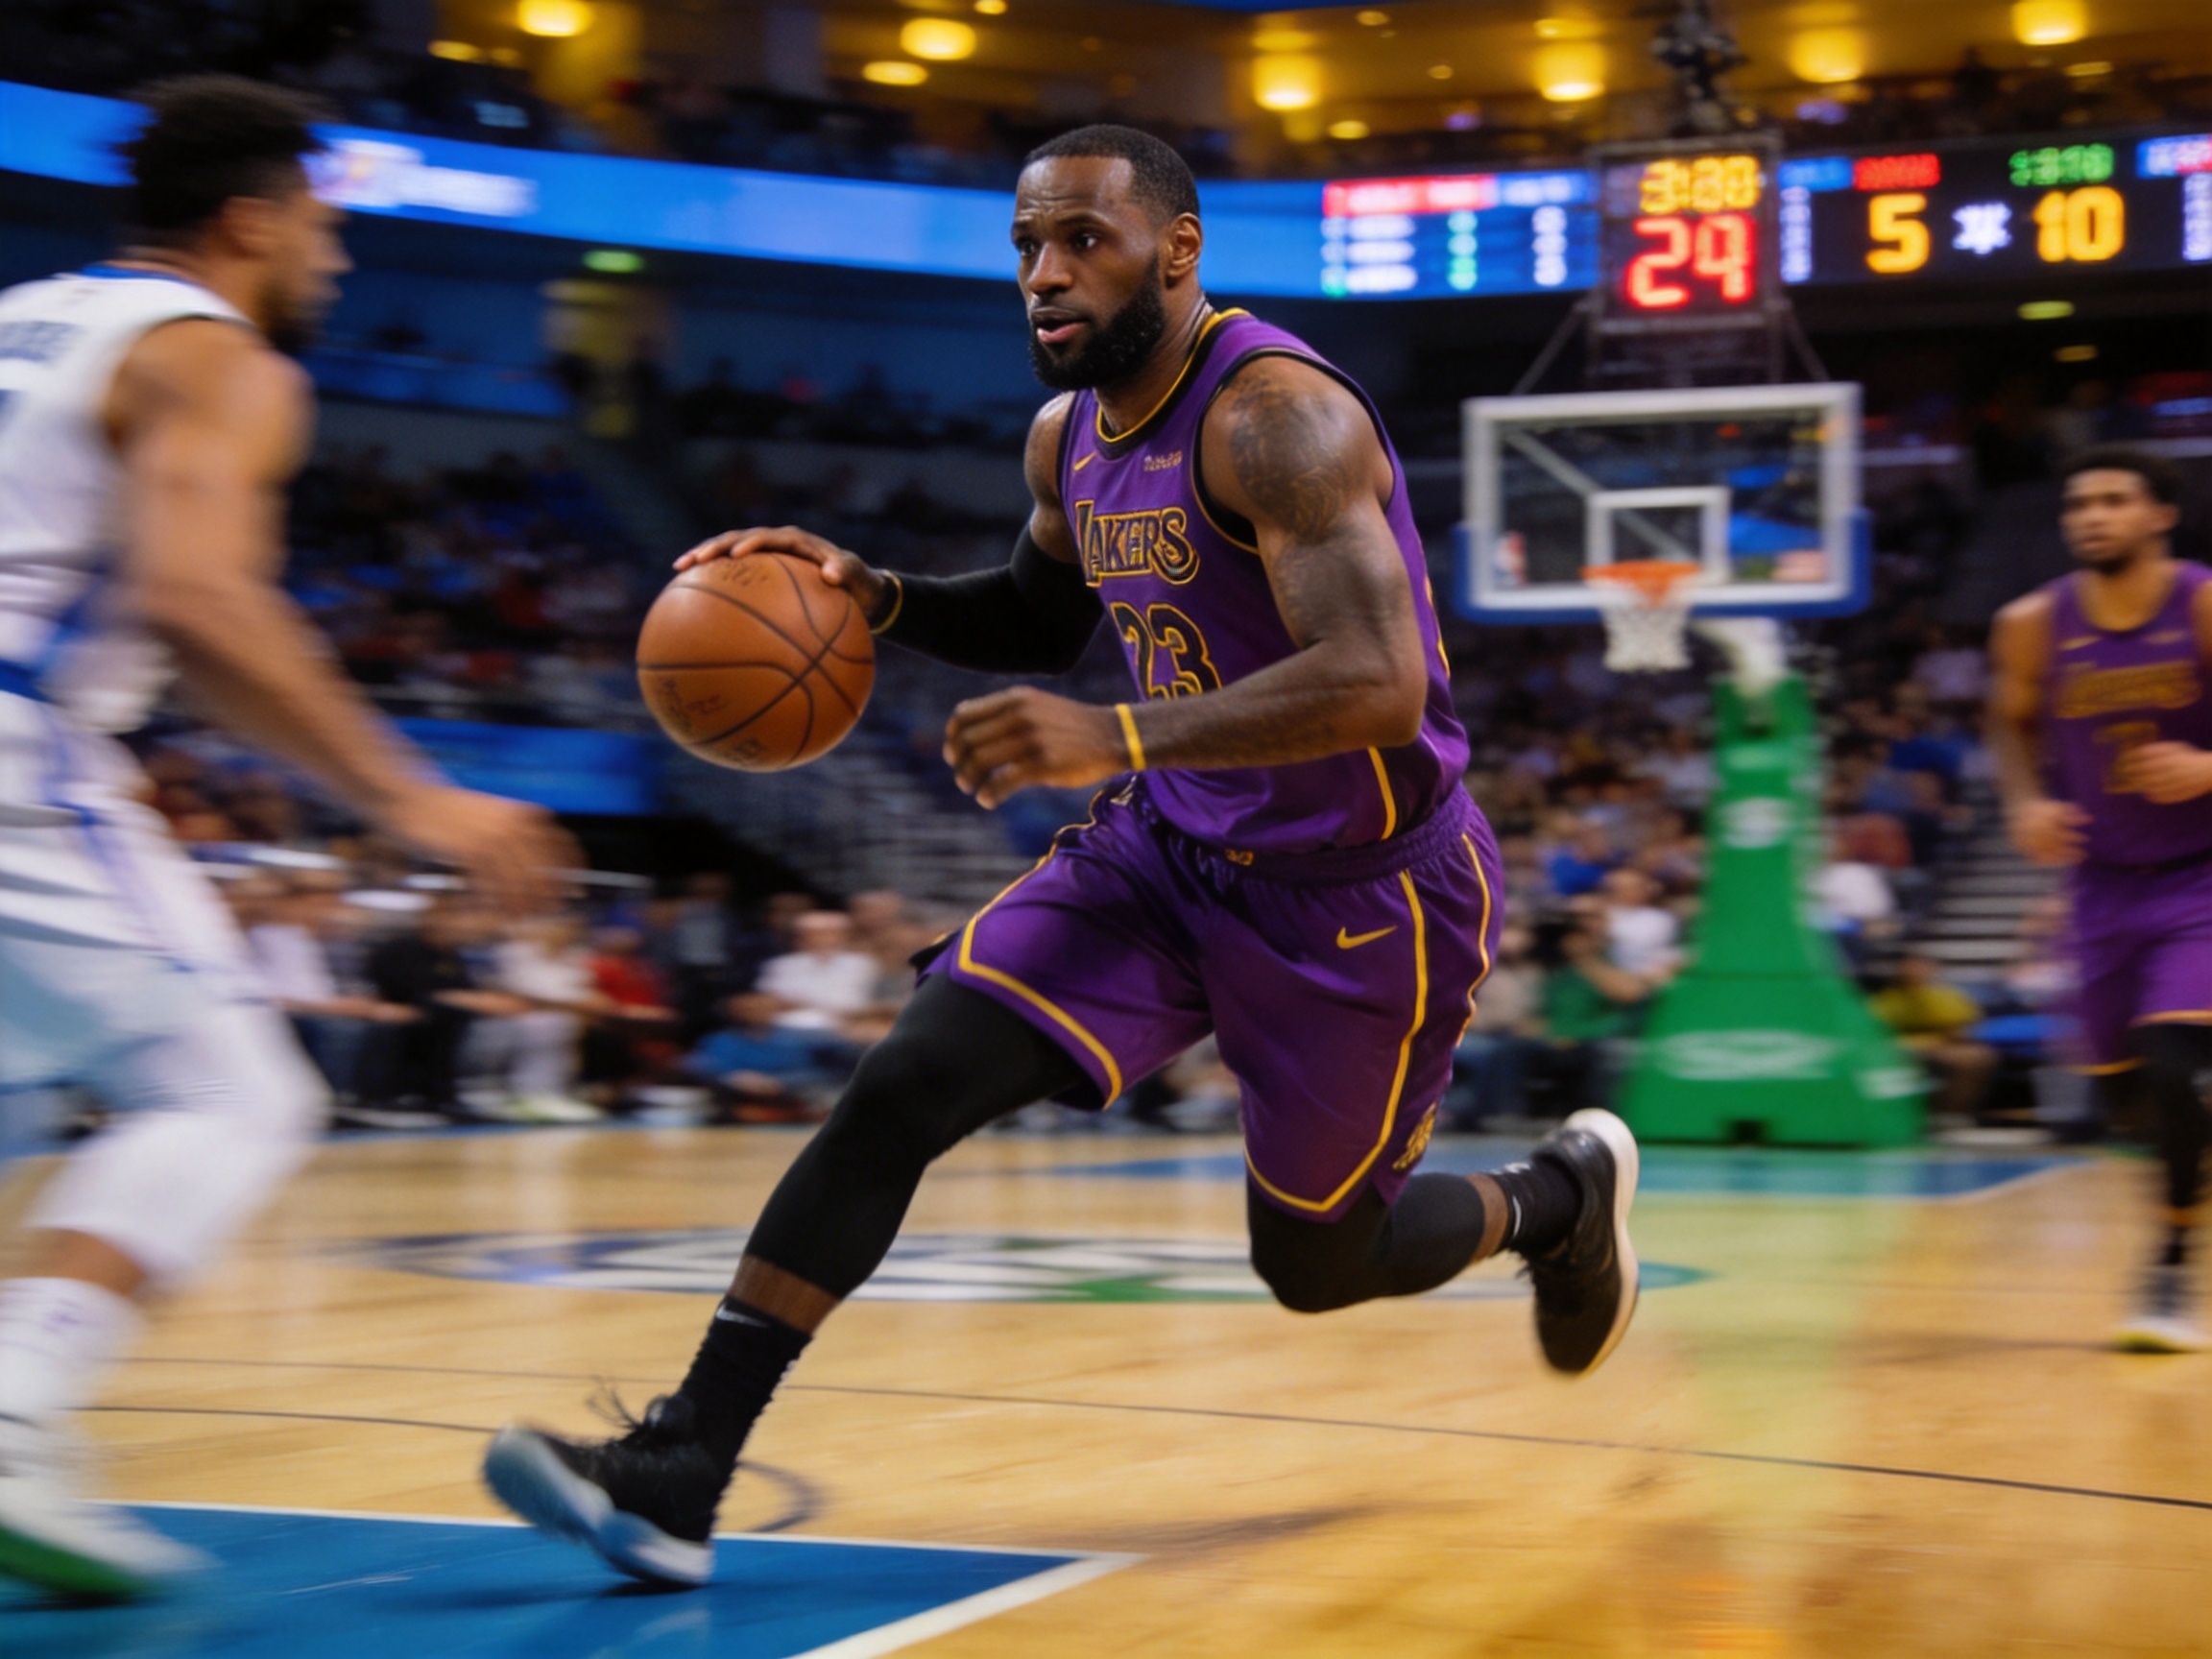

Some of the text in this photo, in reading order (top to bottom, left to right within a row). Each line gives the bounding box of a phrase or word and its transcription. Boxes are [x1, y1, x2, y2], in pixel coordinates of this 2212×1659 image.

[1865, 193, 1931, 274] 5
[2032, 185, 2126, 263] 10
[1075, 498, 1200, 588] LAKERS
[1109, 601, 1222, 702] 23
